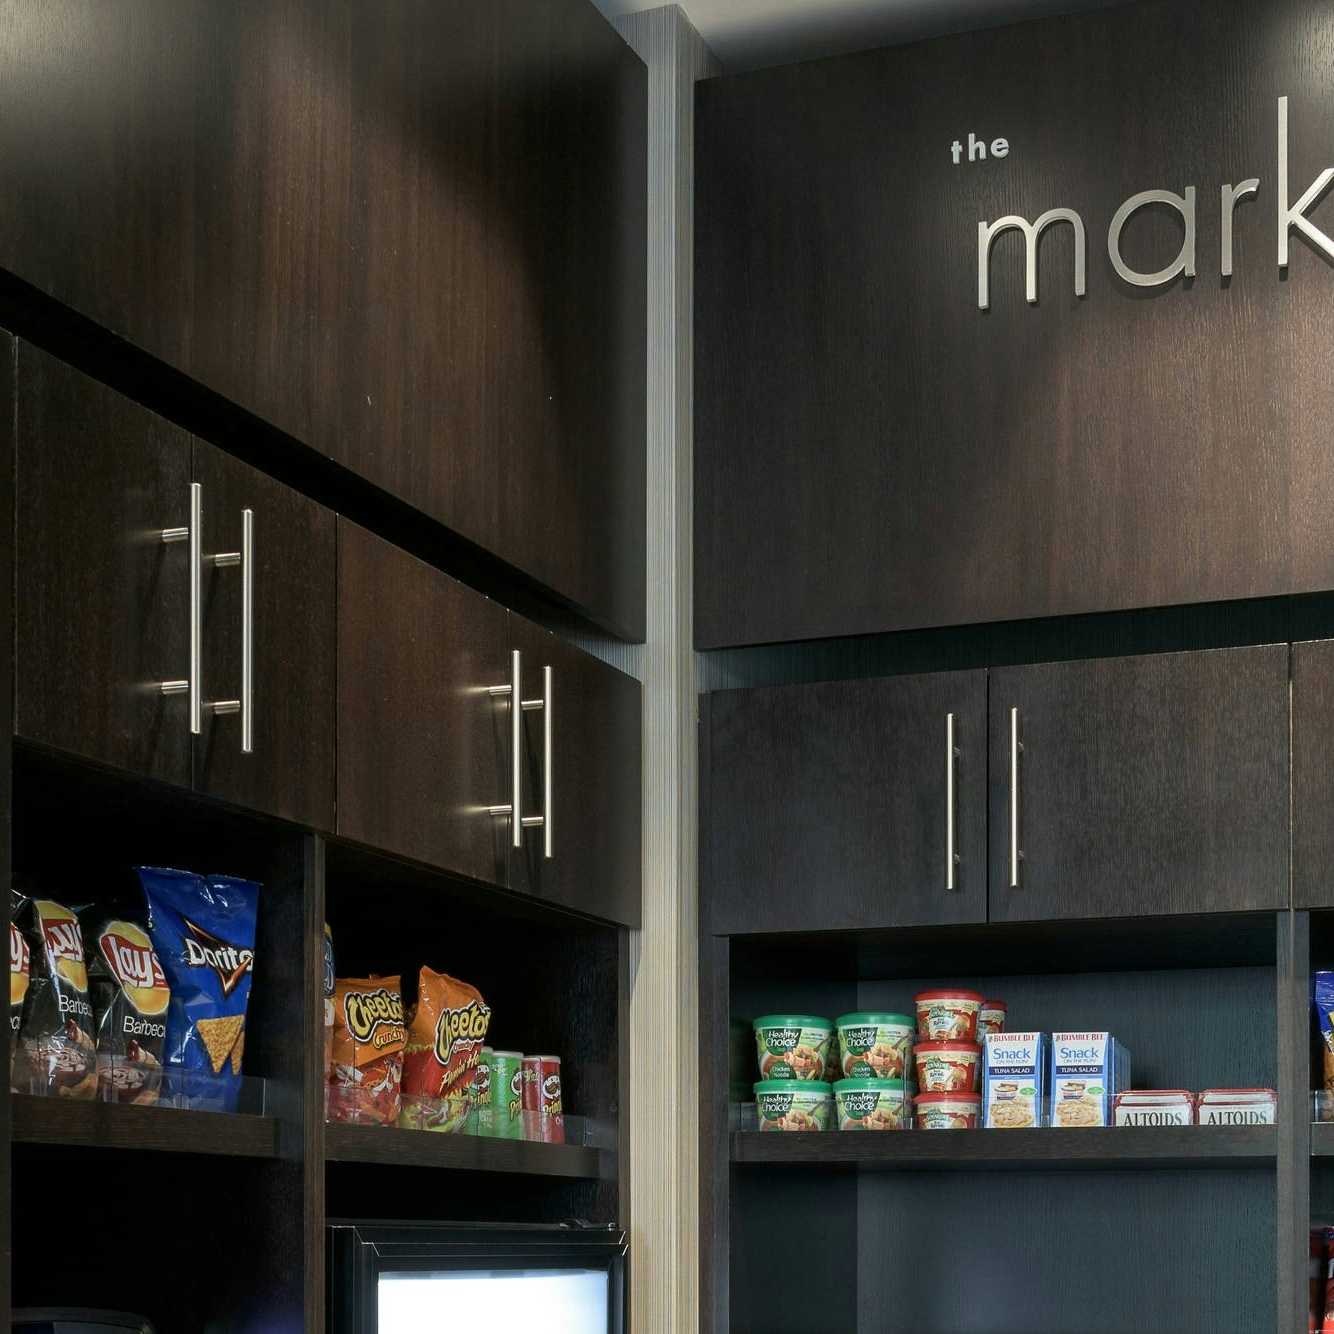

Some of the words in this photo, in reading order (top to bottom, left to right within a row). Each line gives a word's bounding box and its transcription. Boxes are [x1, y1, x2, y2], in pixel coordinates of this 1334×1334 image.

[951, 133, 1009, 165] the
[765, 1037, 797, 1047] Choice
[846, 1036, 874, 1047] Choice
[993, 1048, 1031, 1060] Snack
[1060, 1047, 1098, 1060] Snack
[761, 1102, 789, 1112] Choice
[845, 1101, 875, 1111] Choice
